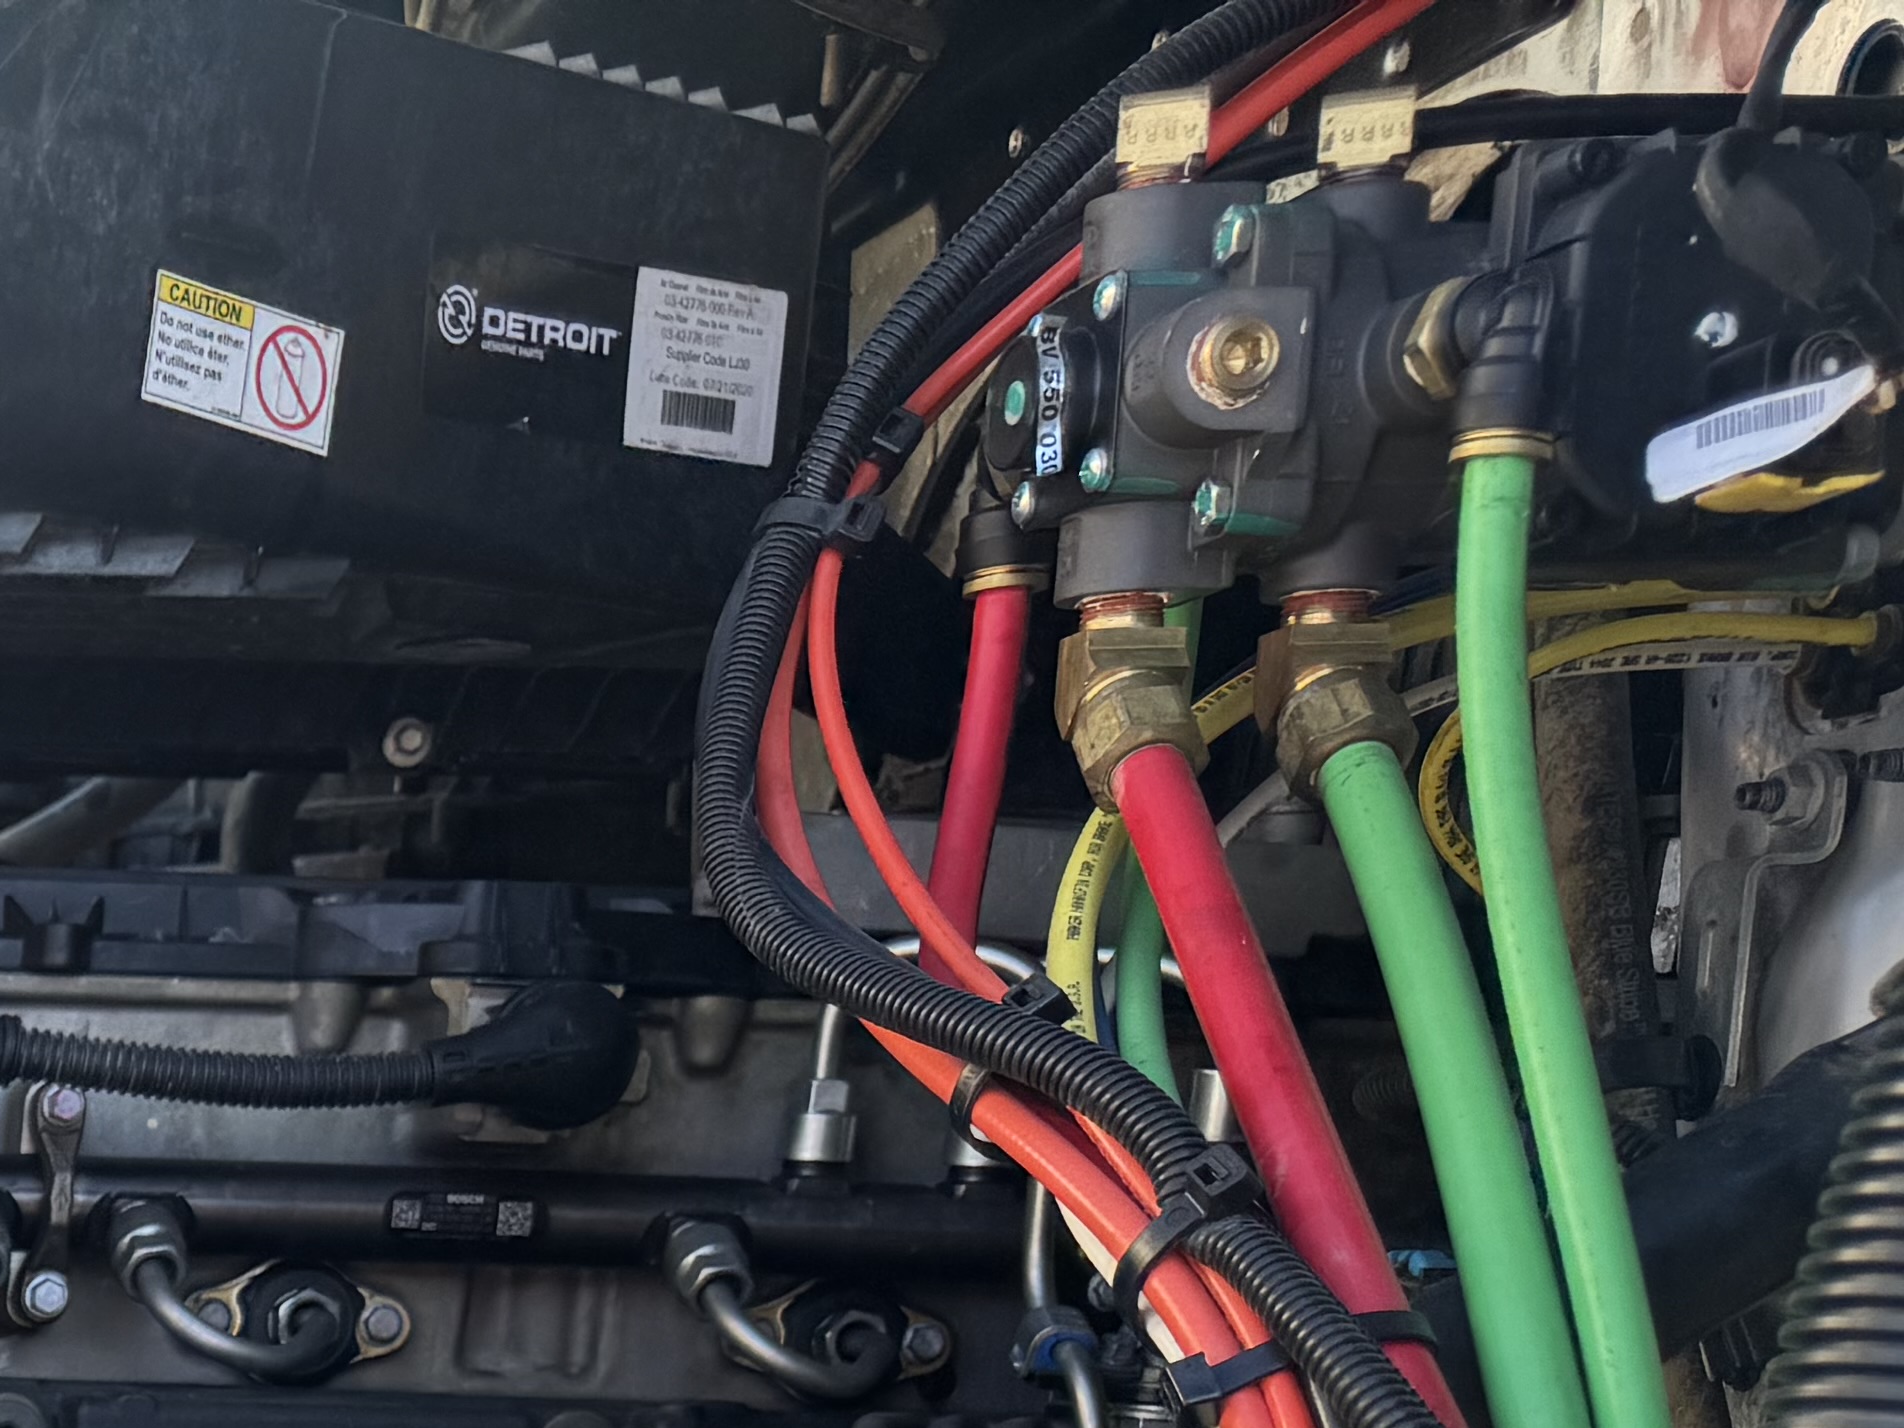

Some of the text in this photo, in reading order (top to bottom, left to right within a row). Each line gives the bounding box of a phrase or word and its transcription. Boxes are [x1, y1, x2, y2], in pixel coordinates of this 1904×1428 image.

[169, 283, 243, 323] CAUTION
[157, 330, 172, 346] No
[159, 311, 174, 327] Do
[176, 318, 193, 333] not
[195, 326, 214, 342] use
[482, 306, 618, 356] DETROIT
[666, 347, 726, 368] Supplier Code
[1040, 327, 1060, 359] BV
[203, 367, 223, 382] pas
[1043, 370, 1061, 421] 550
